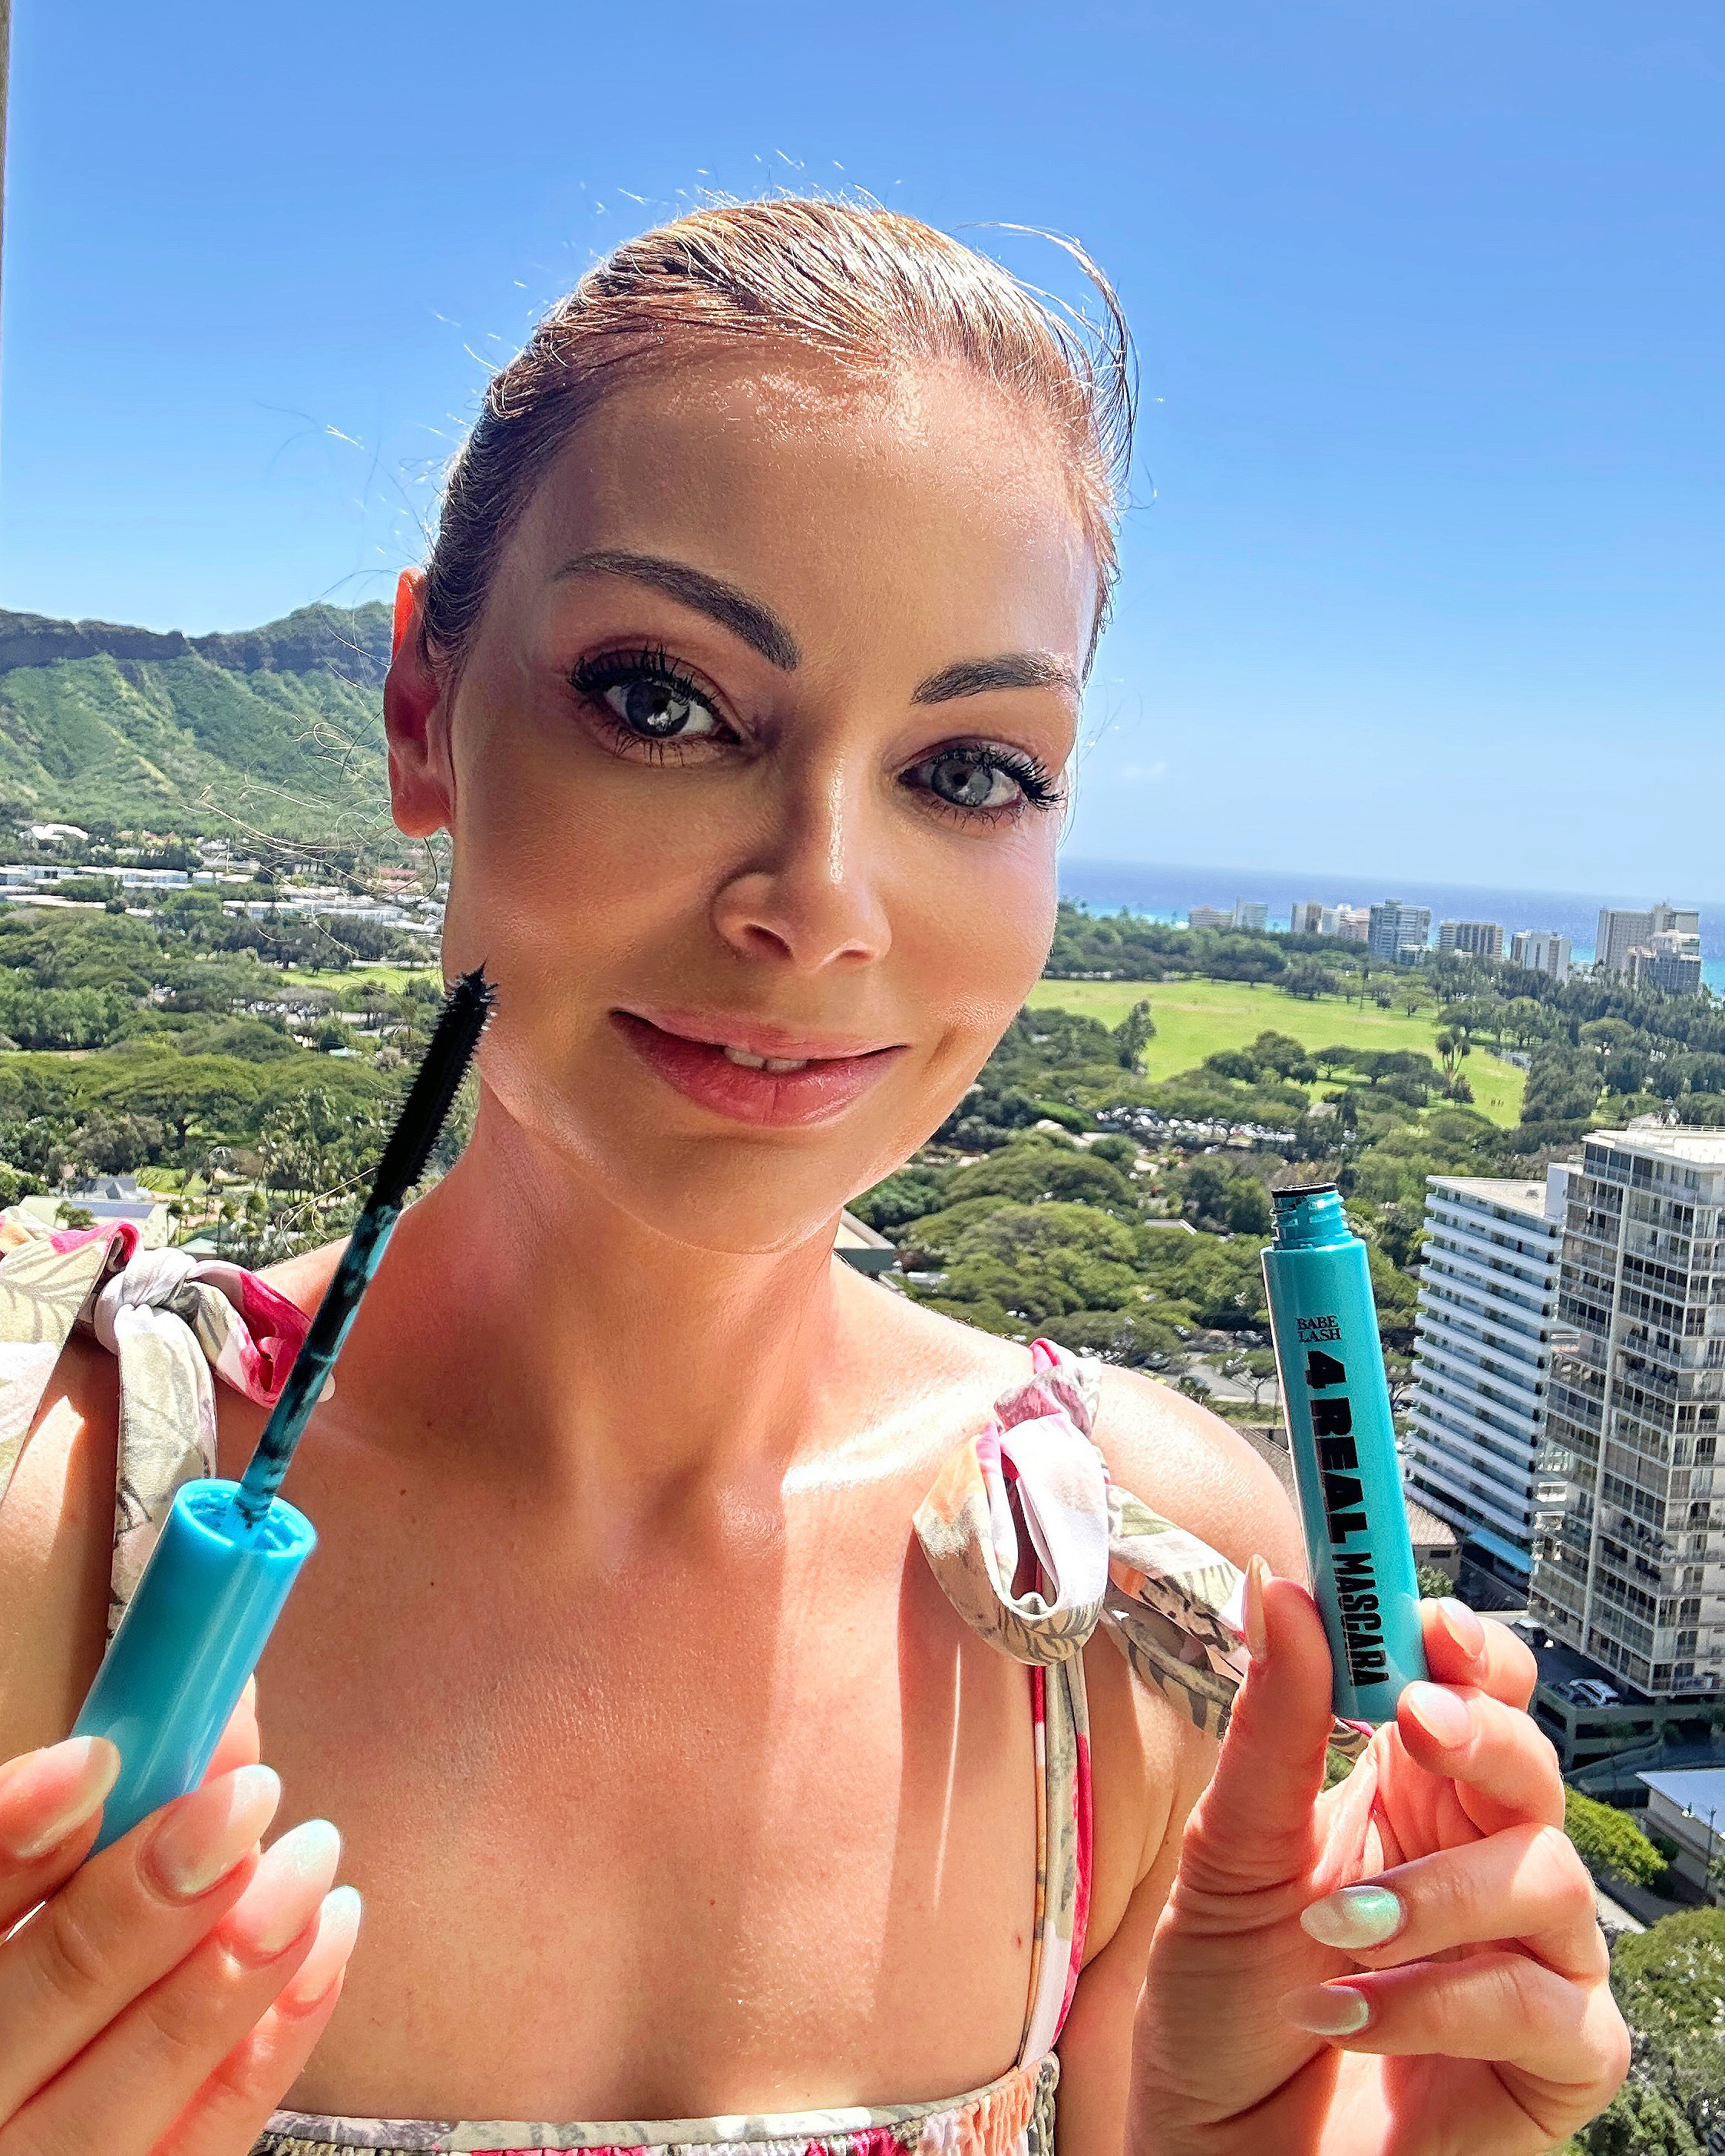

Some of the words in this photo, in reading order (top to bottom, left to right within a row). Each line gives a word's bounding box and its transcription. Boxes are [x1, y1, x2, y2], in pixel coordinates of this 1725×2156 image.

[1296, 1315, 1339, 1329] BABE
[1297, 1328, 1341, 1342] LASH
[1306, 1350, 1346, 1389] 4
[1311, 1398, 1368, 1543] REAL
[1333, 1552, 1389, 1687] MASCARA
